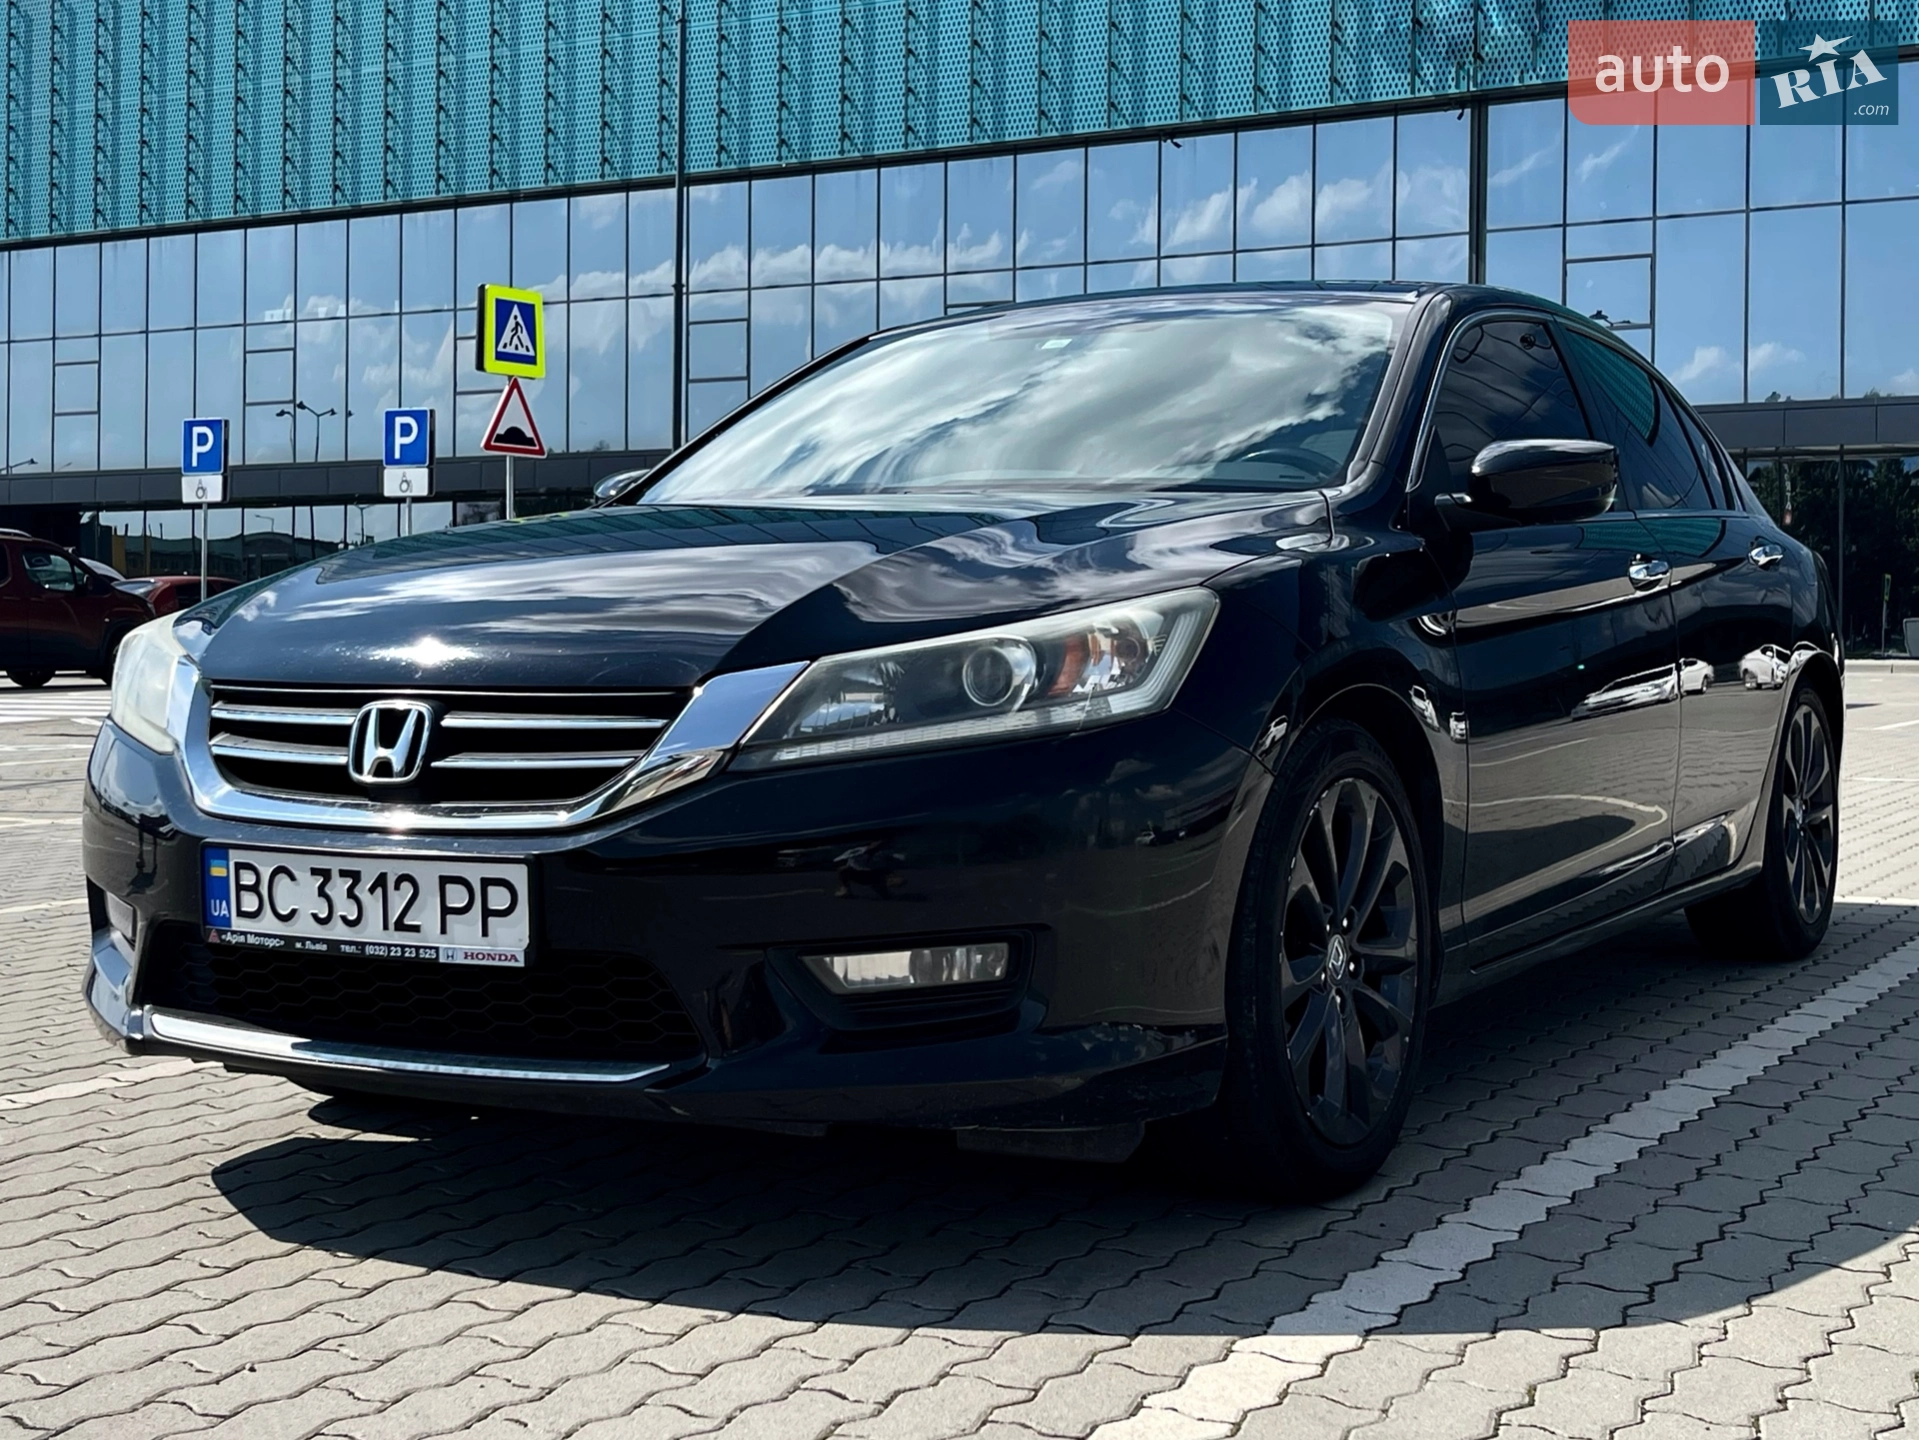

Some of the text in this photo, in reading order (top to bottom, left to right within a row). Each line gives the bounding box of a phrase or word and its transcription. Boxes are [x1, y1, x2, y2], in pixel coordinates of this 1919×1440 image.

[191, 426, 214, 467] P
[394, 416, 419, 460] P
[211, 899, 229, 918] UA
[233, 861, 519, 938] BC 3312 PP
[364, 944, 389, 957] (032)
[390, 946, 402, 957] 23
[404, 947, 416, 957] 23
[419, 947, 437, 959] 525
[463, 951, 520, 963] HONDA
